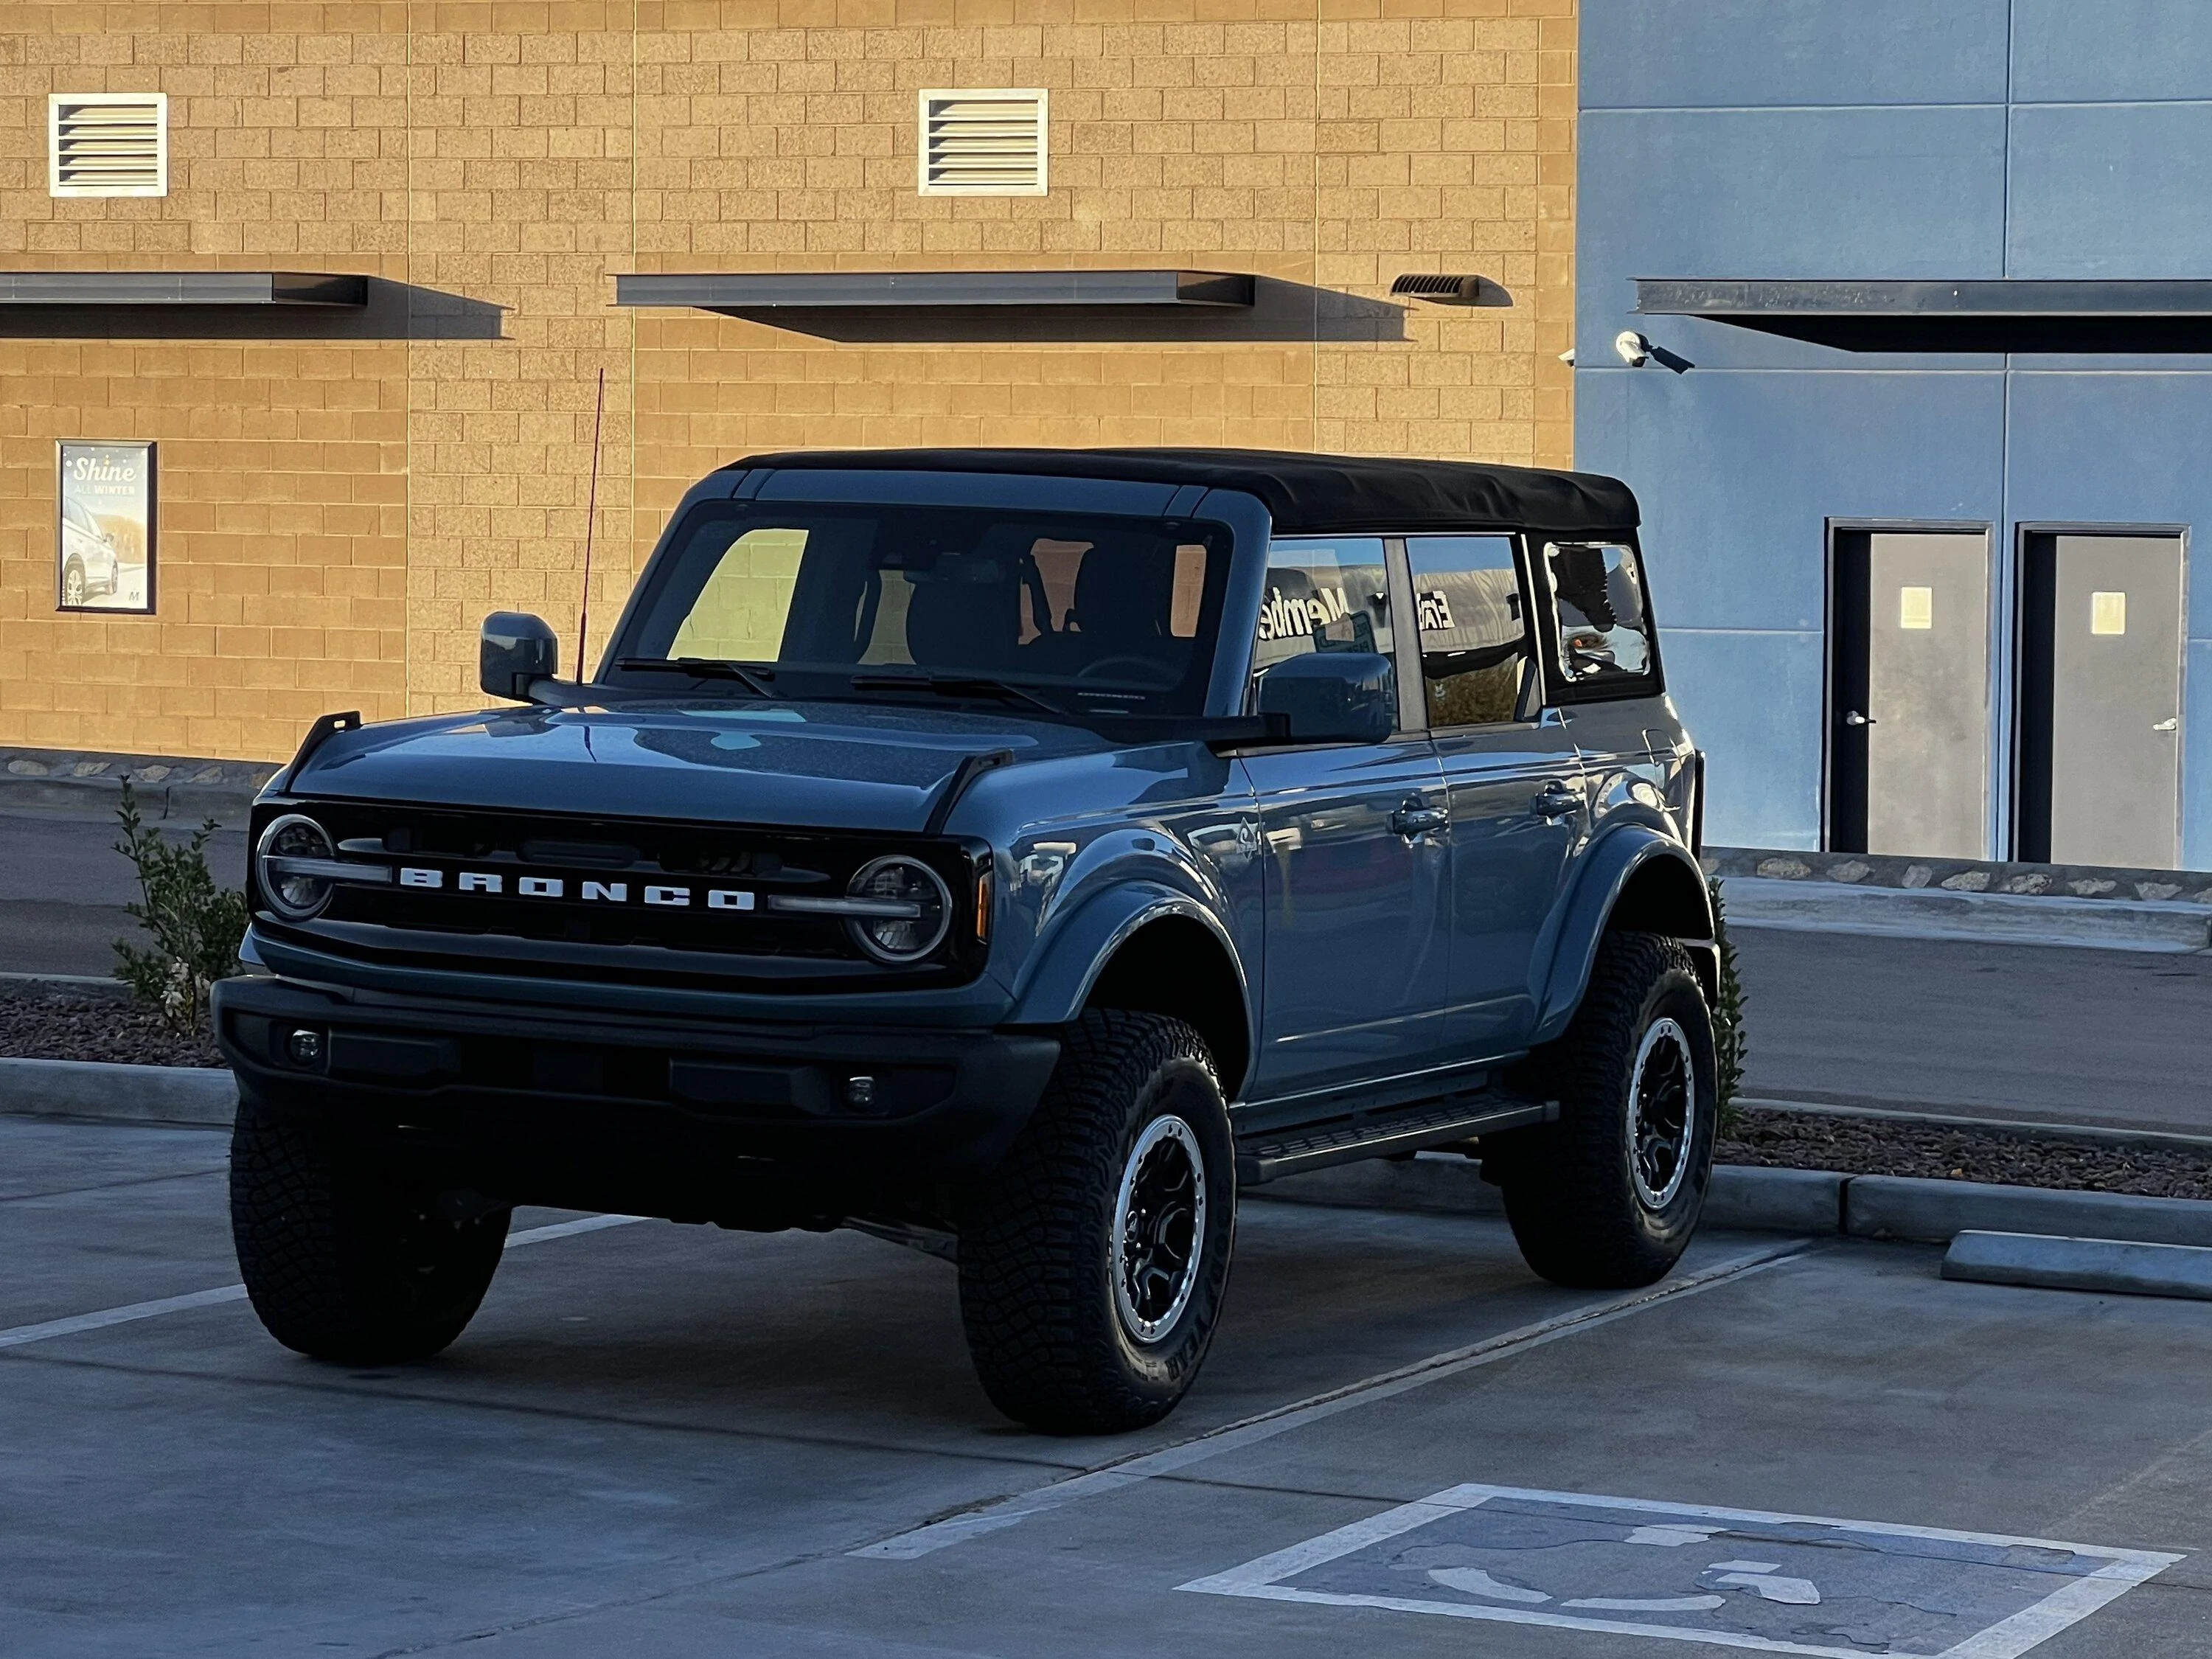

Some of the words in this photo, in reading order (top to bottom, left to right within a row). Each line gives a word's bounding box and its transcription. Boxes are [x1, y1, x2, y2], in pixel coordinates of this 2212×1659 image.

[73, 456, 137, 482] Shine
[74, 485, 92, 495] ALL
[94, 485, 136, 495] WINTER
[400, 868, 754, 910] BRONCO
